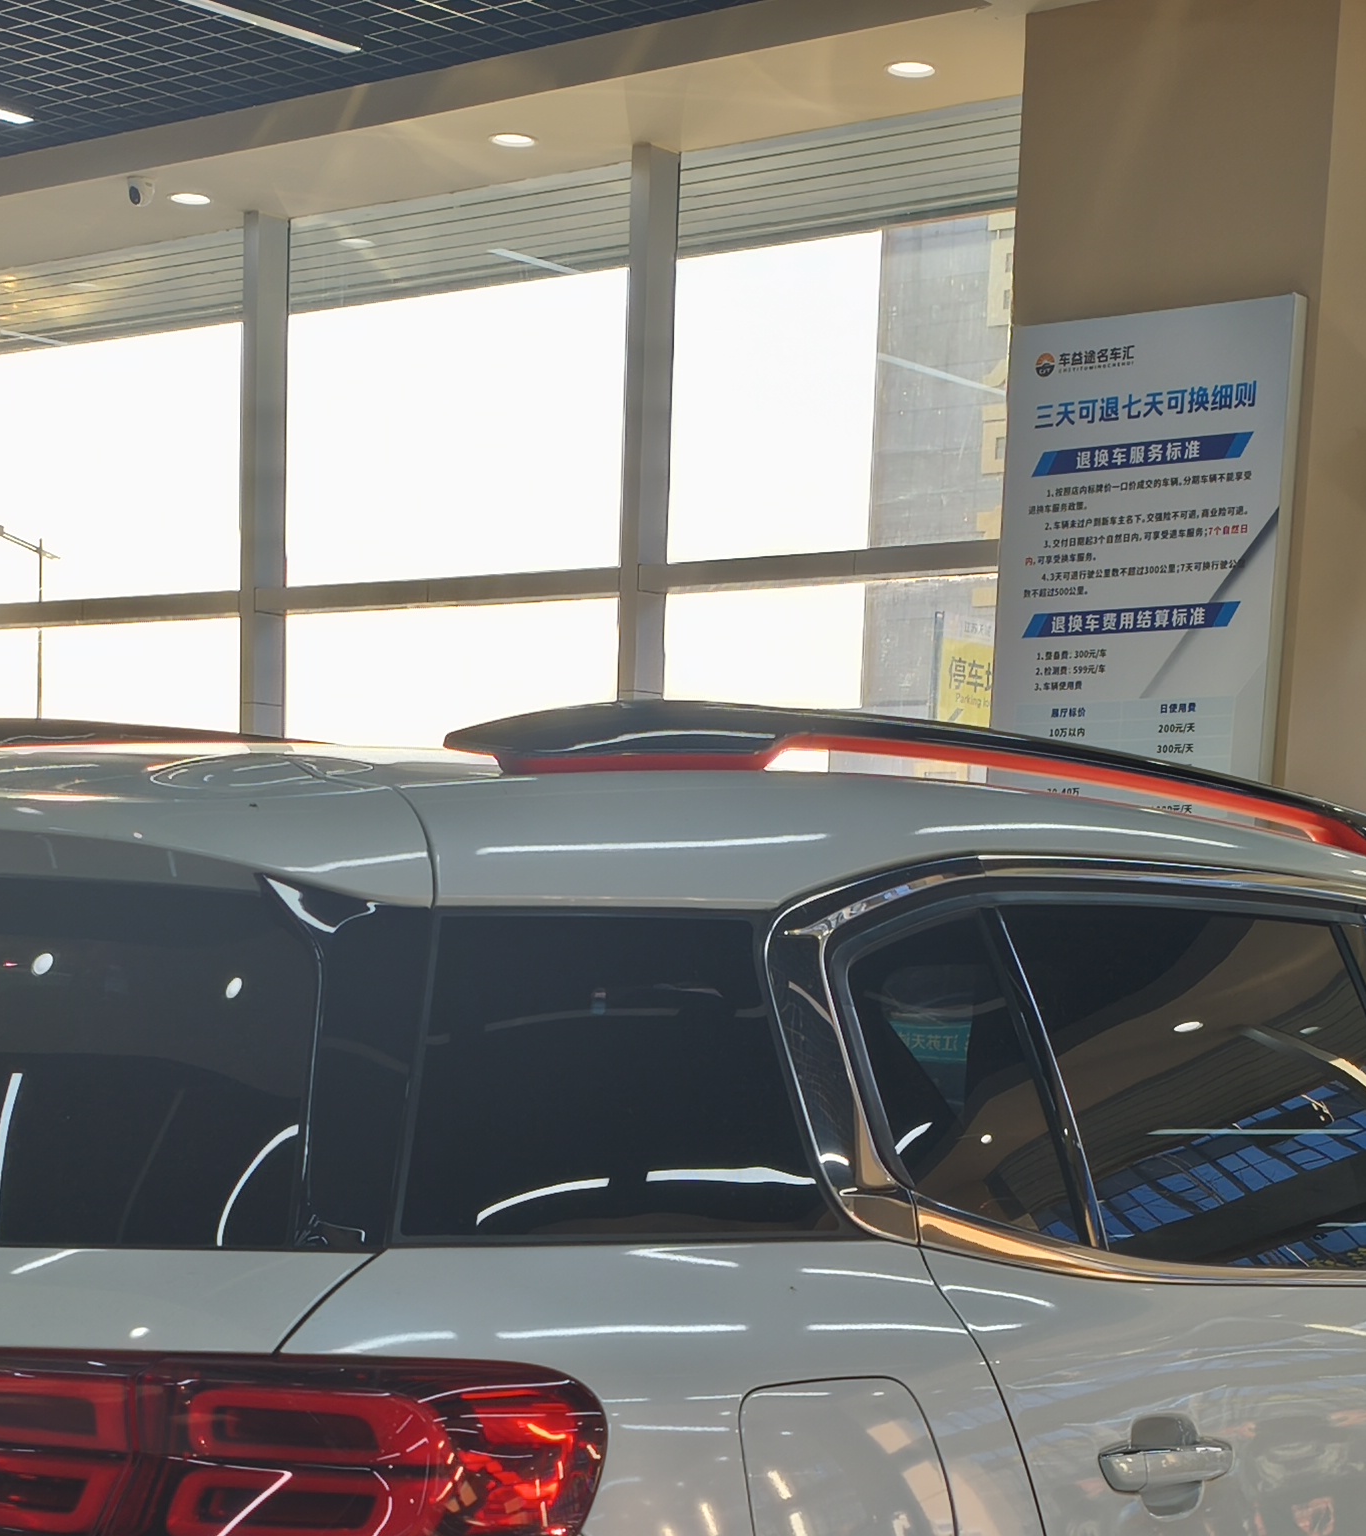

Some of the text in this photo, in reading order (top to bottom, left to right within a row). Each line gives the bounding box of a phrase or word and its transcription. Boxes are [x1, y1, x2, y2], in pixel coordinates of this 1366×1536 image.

[1058, 345, 1135, 367] 车益途名车汇
[1034, 380, 1257, 429] 三天可退七天可换细则
[1075, 440, 1201, 469] 退换车服务标准
[1050, 607, 1206, 634] 退换车费用结算标准
[1049, 722, 1195, 738] 10万以内 200元/天
[1157, 743, 1194, 754] 300元/天
